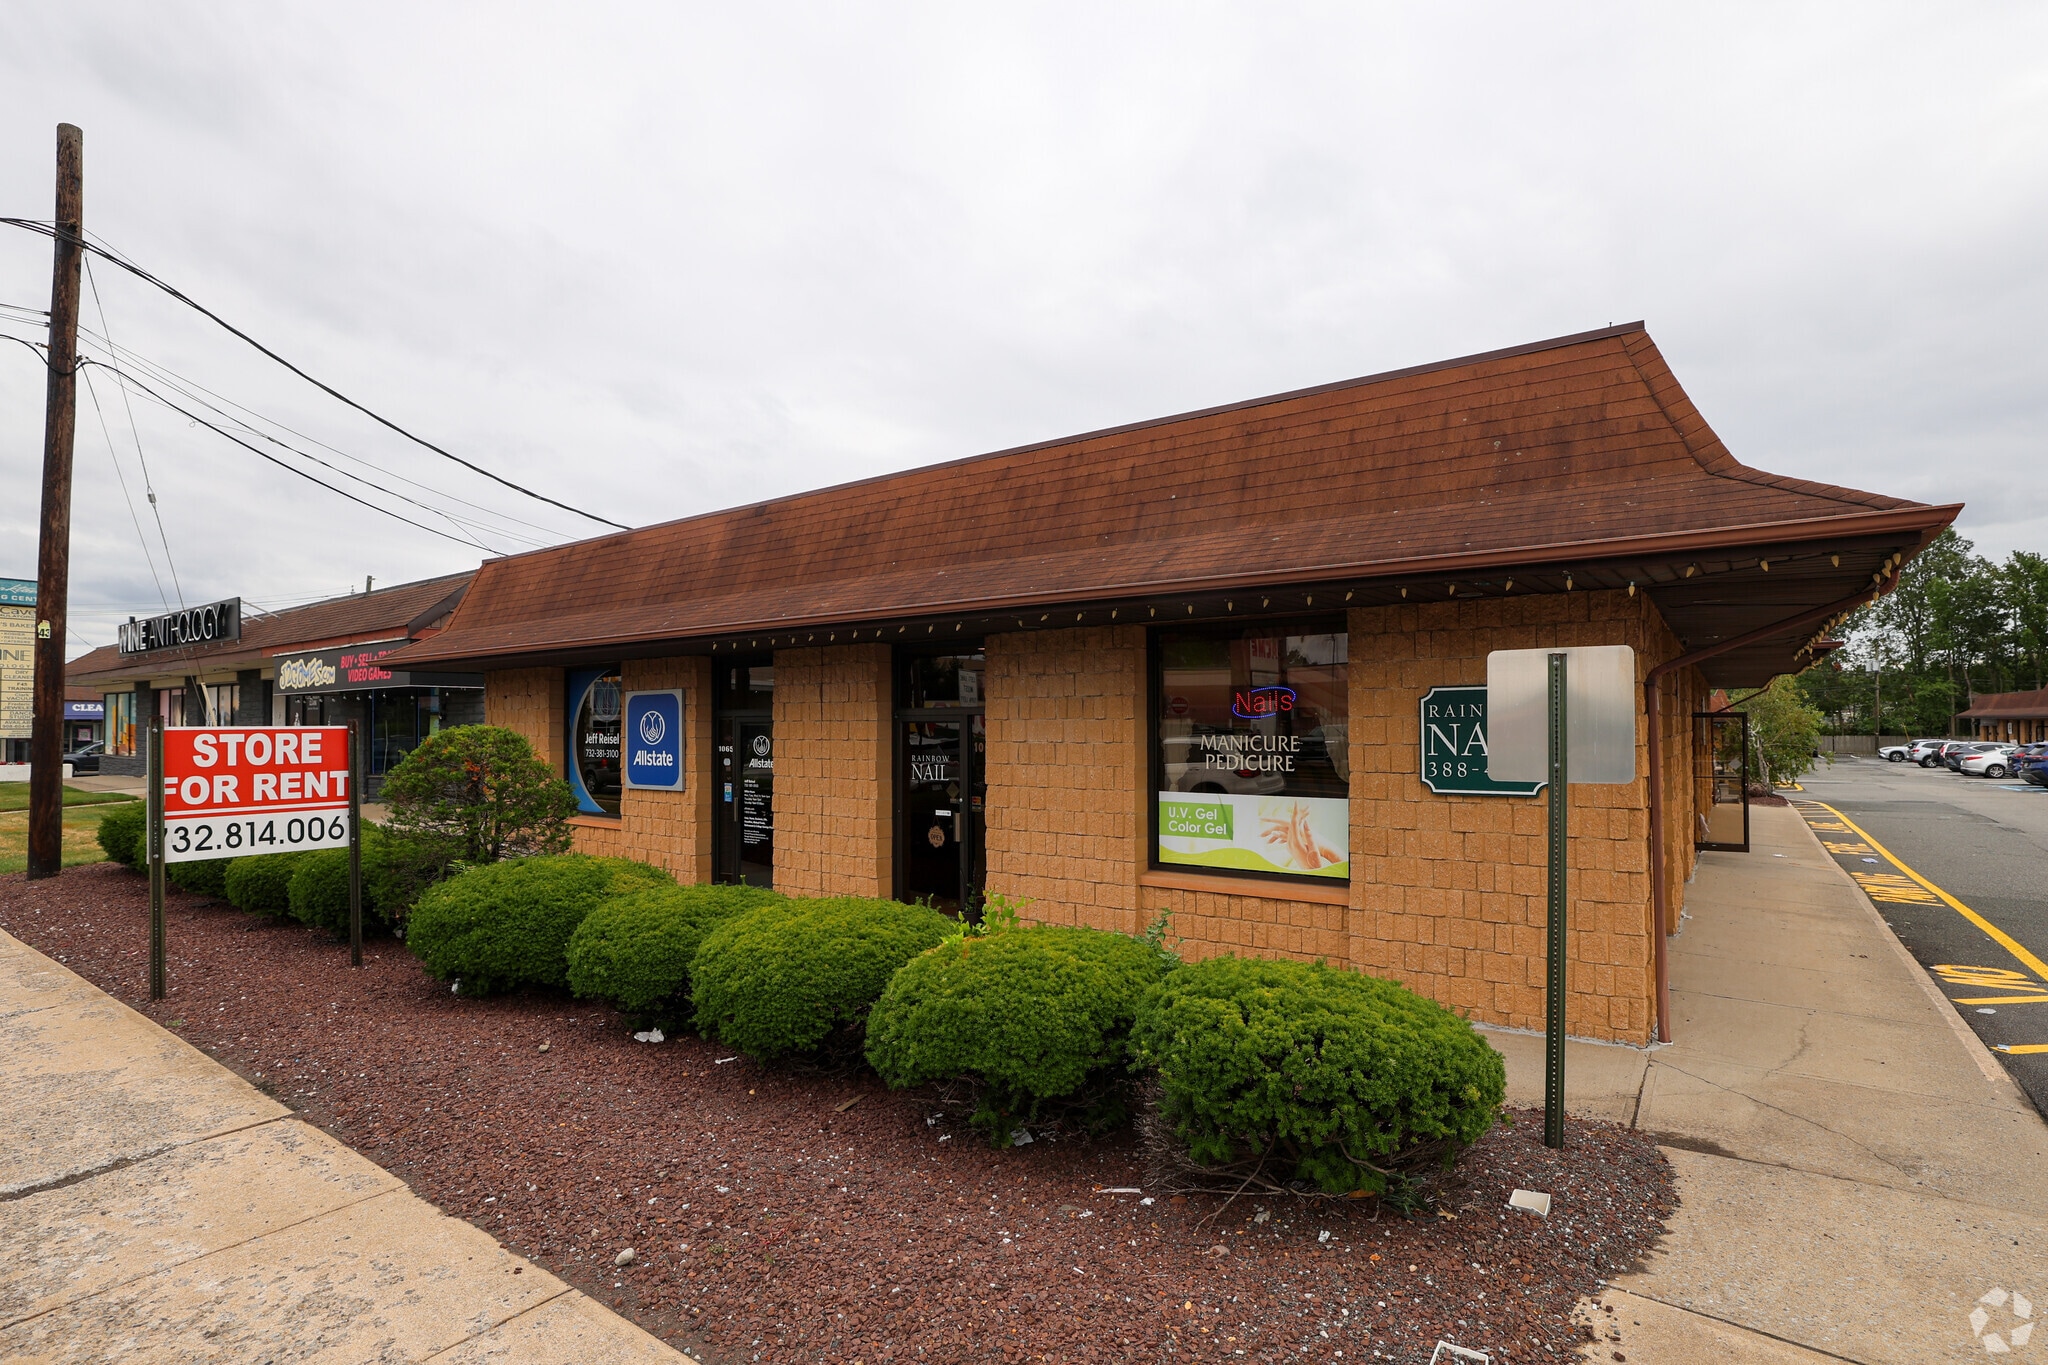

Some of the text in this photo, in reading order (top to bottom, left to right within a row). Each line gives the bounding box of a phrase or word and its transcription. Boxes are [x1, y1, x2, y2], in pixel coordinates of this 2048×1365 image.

[119, 606, 222, 653] WINE ANTHOLOGY
[341, 654, 355, 669] BUY
[347, 668, 368, 682] VIDEO
[1236, 690, 1293, 713] Nails
[1428, 703, 1484, 718] RAIN
[585, 733, 620, 745] Jeff Reisel
[1200, 734, 1301, 752] MANICURE
[1426, 721, 1488, 757] NA
[193, 732, 322, 768] STORE
[585, 749, 619, 758] 732-381-3100
[633, 750, 673, 767] Allstate
[911, 754, 950, 762] RAINBOW
[749, 758, 774, 769] Allstate
[911, 763, 950, 780] NAIL
[1205, 754, 1296, 772] PEDICURE
[1428, 761, 1488, 778] 388-
[253, 771, 349, 801] RENT
[1168, 806, 1218, 820] U.V. Gel
[164, 816, 349, 853] 32.814.006
[1168, 820, 1227, 835] Color Gel
